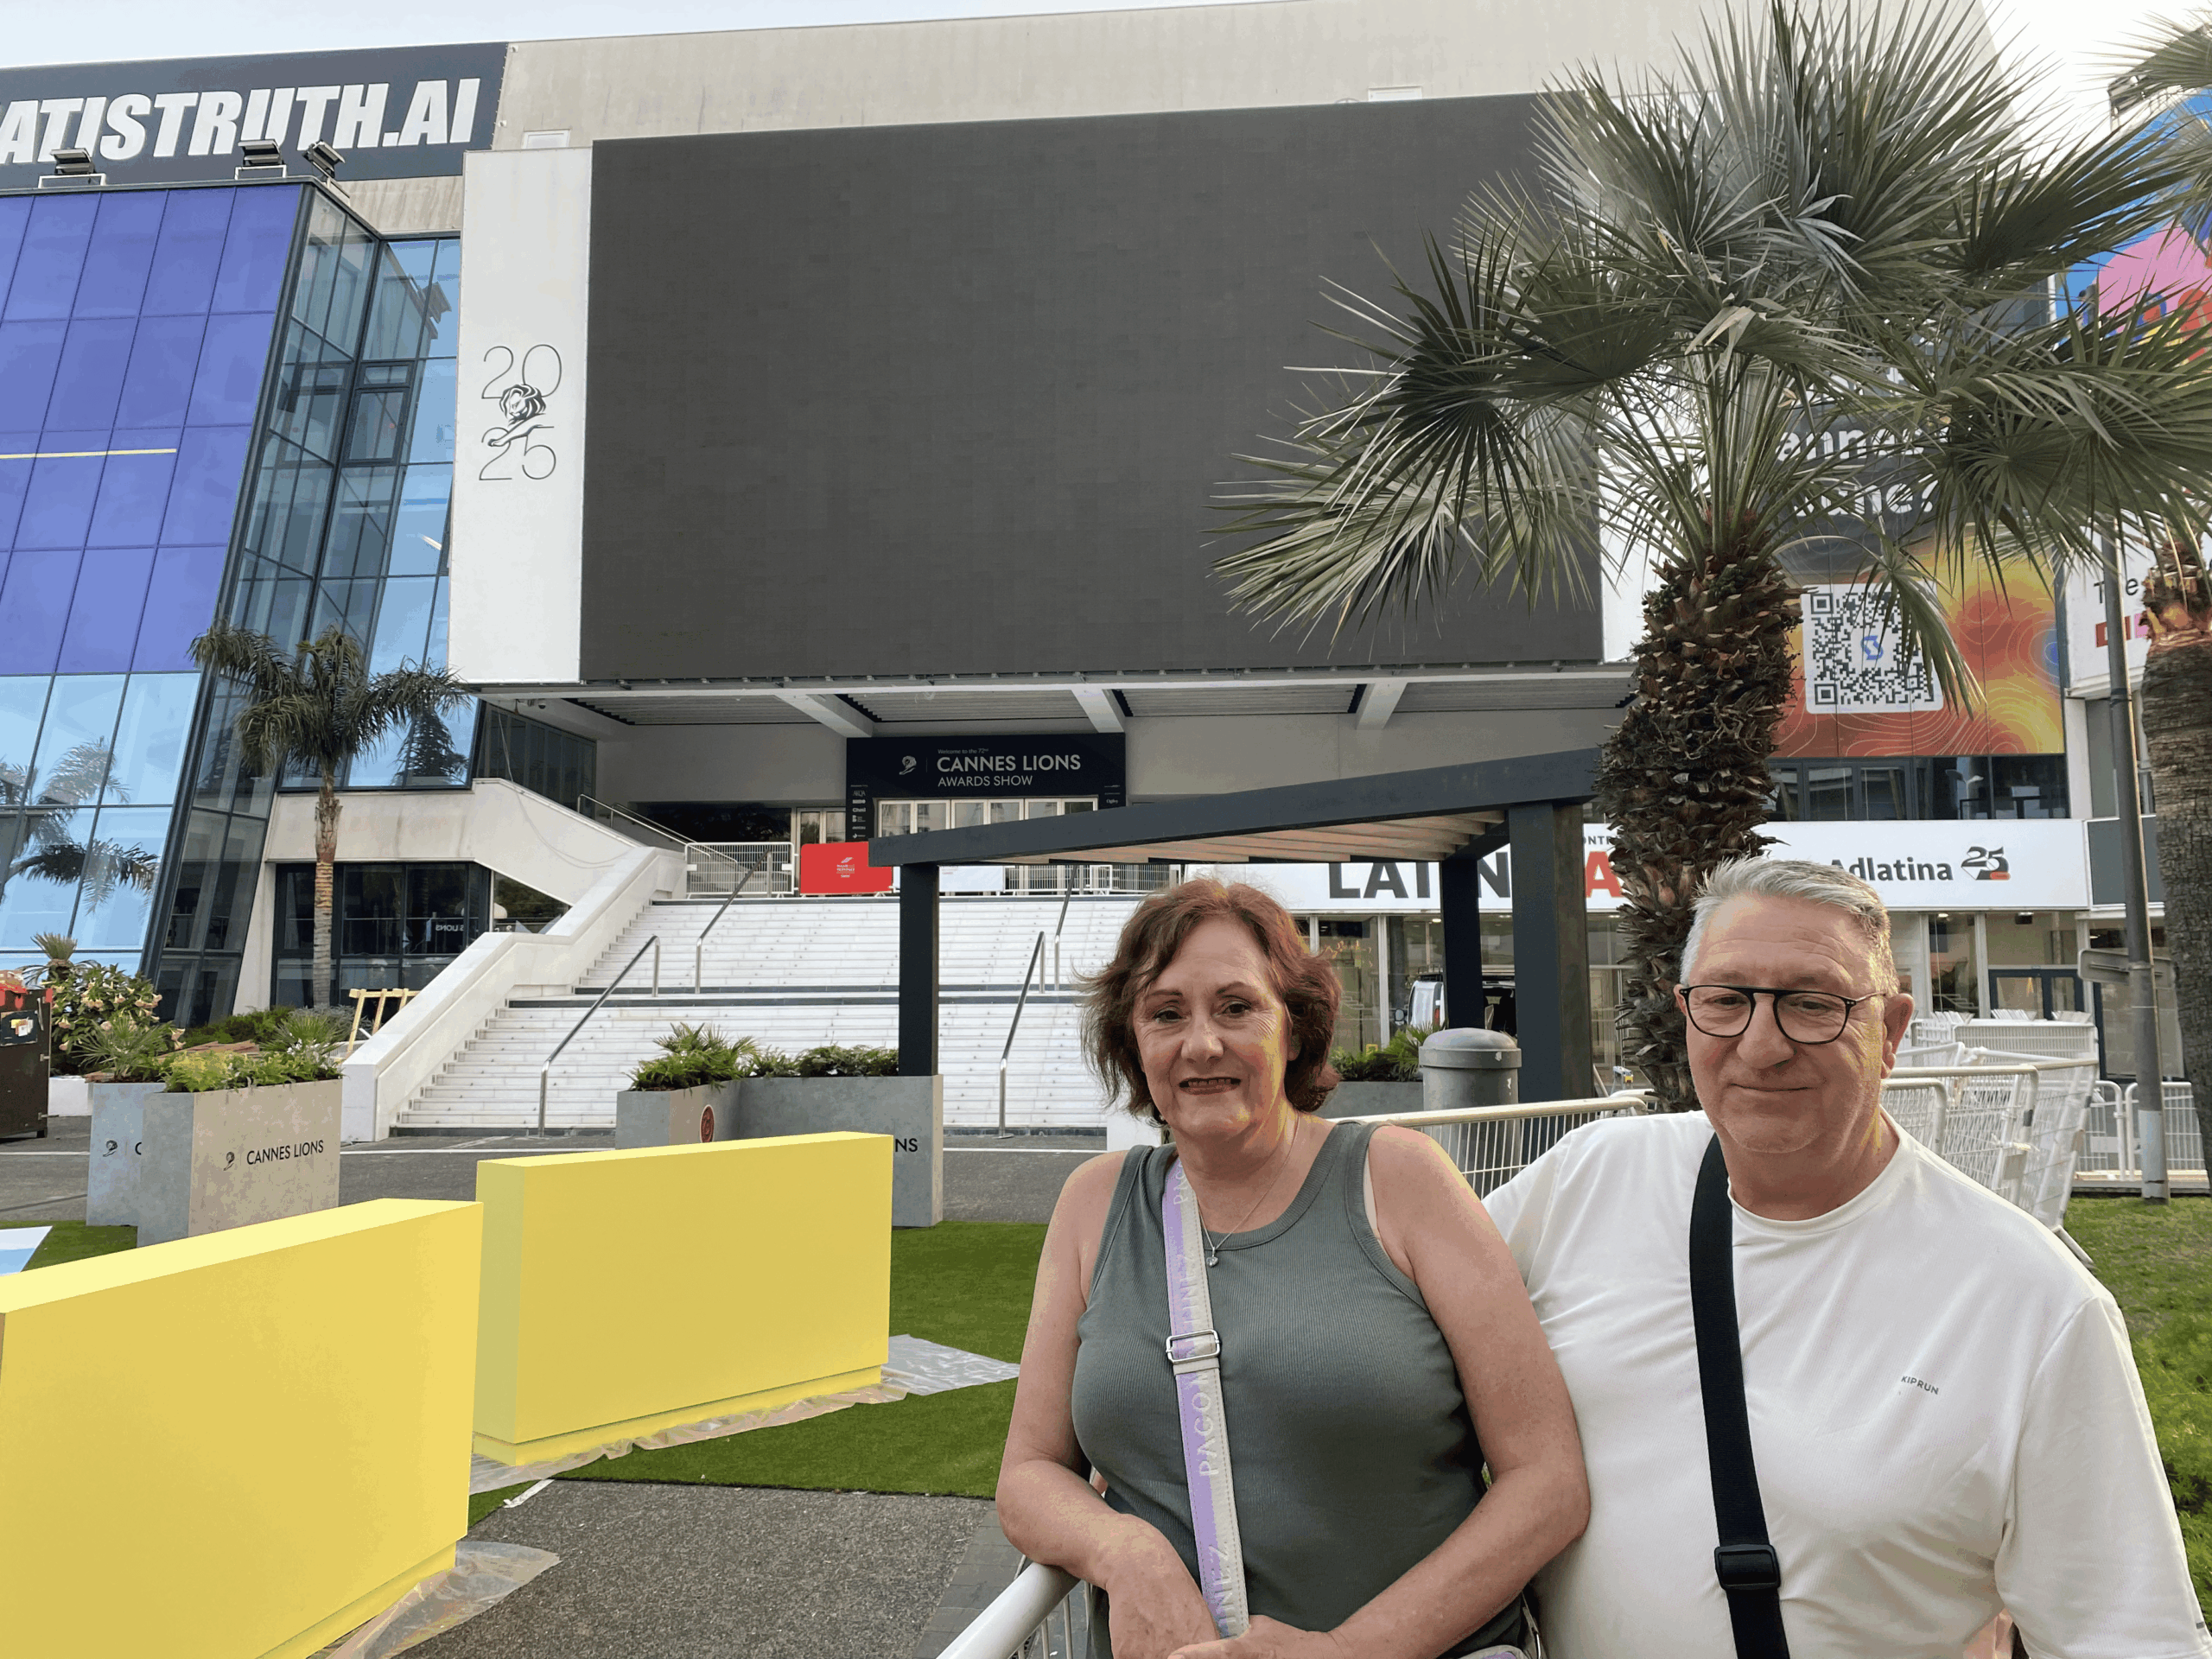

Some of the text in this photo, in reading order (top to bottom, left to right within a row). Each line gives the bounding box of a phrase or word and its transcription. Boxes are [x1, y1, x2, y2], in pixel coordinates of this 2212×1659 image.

[0, 78, 480, 164] ATISTRUTH.AI
[481, 344, 563, 400] 20
[479, 427, 556, 480] 25
[937, 754, 1082, 772] CANNES LIONS
[938, 775, 1033, 787] AWARDS SHOW
[246, 1140, 324, 1165] CANNES LIONS
[1901, 1376, 1939, 1395] KIPRUN
[1190, 1390, 1220, 1478] PACO
